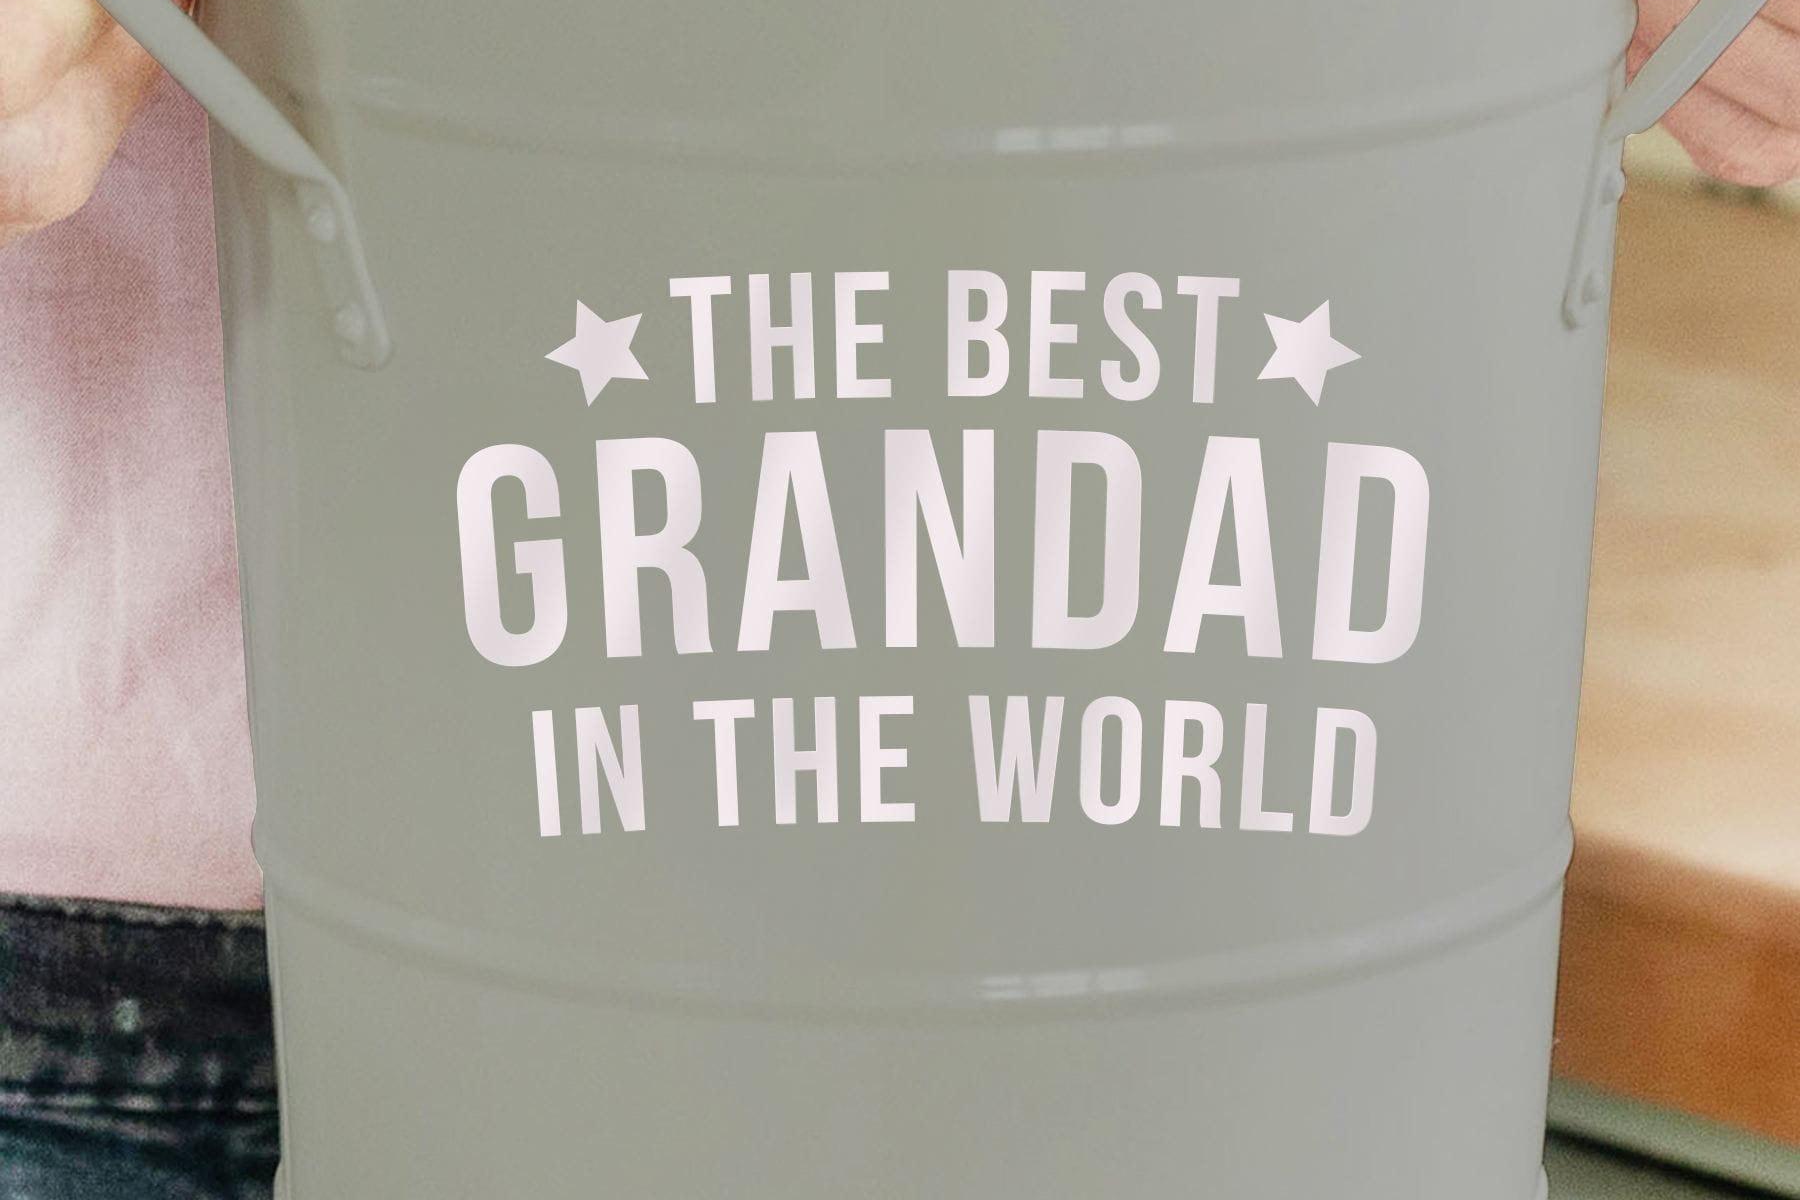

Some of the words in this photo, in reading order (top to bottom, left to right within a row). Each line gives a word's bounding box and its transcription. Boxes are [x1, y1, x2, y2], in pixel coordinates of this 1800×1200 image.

[669, 271, 892, 404] THE
[947, 269, 1241, 403] BEST
[456, 428, 1431, 668] GRANDAD
[532, 703, 646, 837] IN
[693, 695, 916, 827] THE
[968, 695, 1378, 837] WORLD
